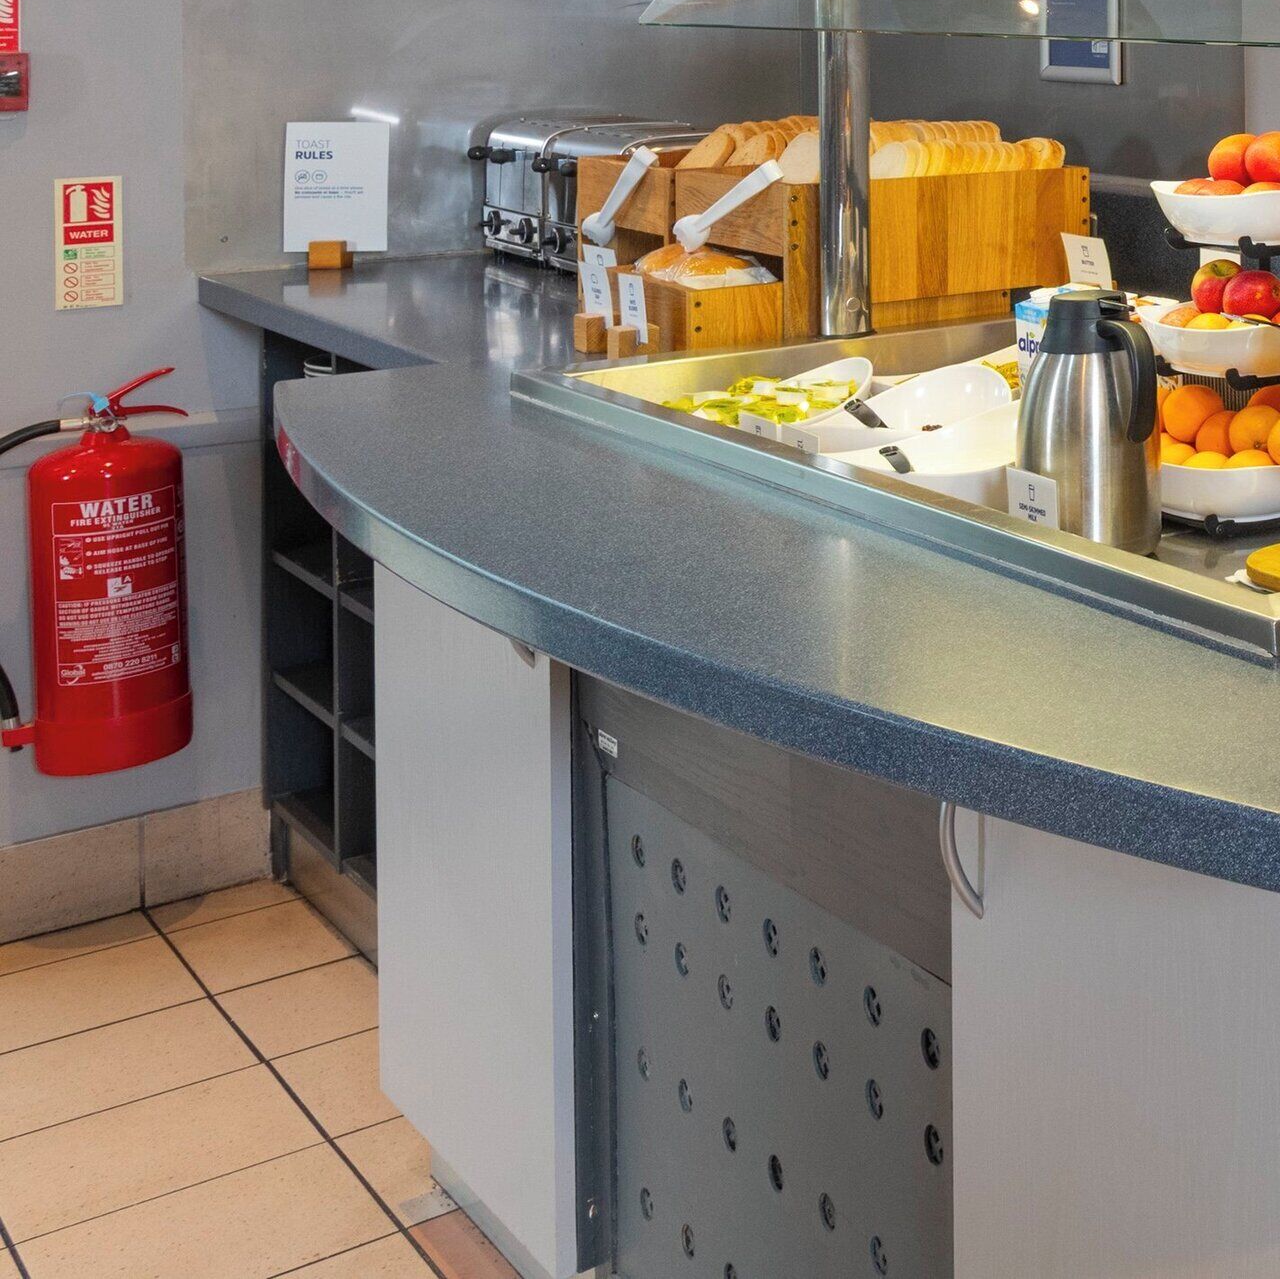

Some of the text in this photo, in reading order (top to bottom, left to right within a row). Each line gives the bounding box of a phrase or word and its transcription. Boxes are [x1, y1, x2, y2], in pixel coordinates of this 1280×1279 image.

[296, 139, 331, 149] TOAST
[295, 150, 334, 160] RULES
[69, 229, 109, 240] WATER
[1018, 332, 1040, 358] alpr
[79, 493, 153, 519] WATER
[70, 506, 161, 527] FIRE EXTINGUISHER
